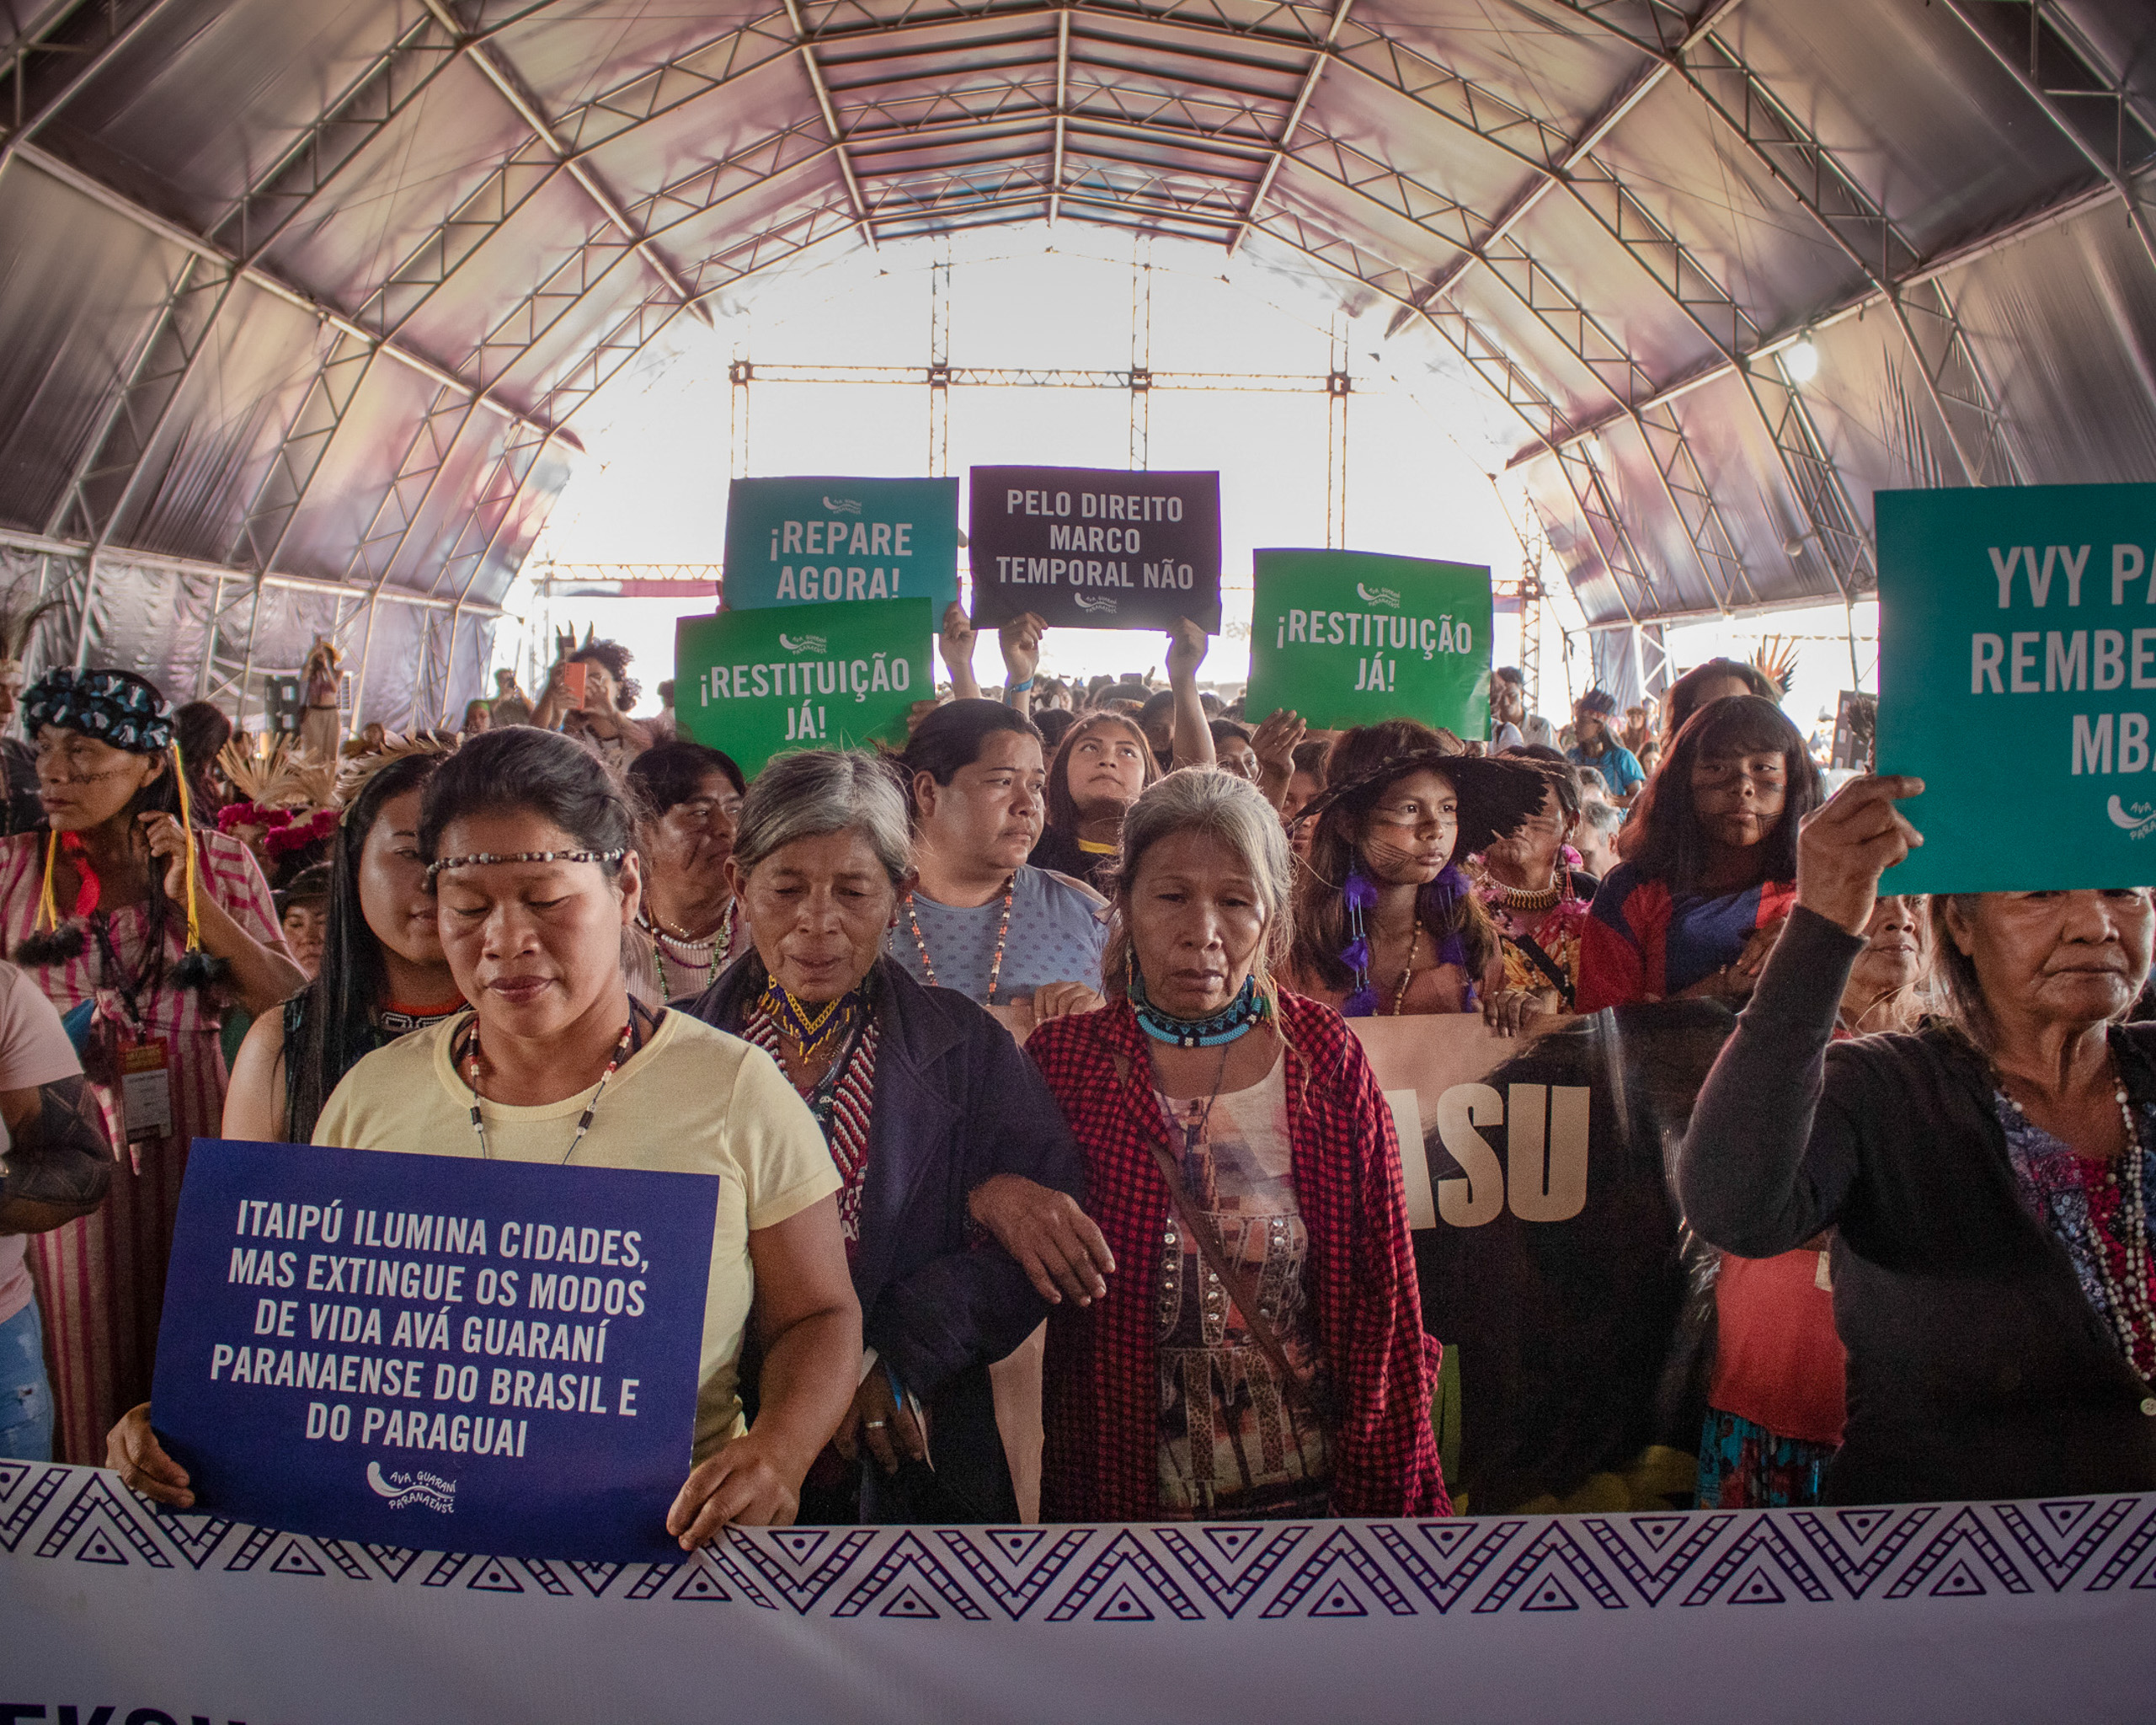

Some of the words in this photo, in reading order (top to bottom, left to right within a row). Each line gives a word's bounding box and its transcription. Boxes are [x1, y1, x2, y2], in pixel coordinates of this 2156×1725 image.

[1007, 489, 1071, 516] PELO
[1081, 492, 1183, 522] DIREITO
[770, 521, 913, 562] ¡REPARE
[1050, 524, 1141, 554] MARCO
[775, 565, 899, 601] AGORA!
[995, 556, 1134, 587] TEMPORAL
[1143, 558, 1193, 590] NÃO
[1988, 544, 2091, 608] YVY
[2111, 543, 2156, 606] P
[1276, 608, 1472, 660] ¡RESTITUIÇÃO
[700, 652, 910, 708] ¡RESTITUIÇÃO
[1354, 651, 1396, 692] JÁ!
[784, 698, 826, 740] JÁ!
[2071, 713, 2156, 776] MB
[236, 1199, 343, 1243] ITAIPÚ
[353, 1210, 487, 1255] ILUMINA
[499, 1221, 649, 1274] CIDADES,
[227, 1247, 297, 1288] MAS
[306, 1254, 466, 1303] EXTINGUE
[475, 1268, 520, 1307] OS
[528, 1273, 647, 1317] MODOS
[253, 1298, 298, 1338] DE
[309, 1303, 382, 1345] VIDA
[391, 1305, 450, 1351] AVÁ
[461, 1316, 611, 1365] GUARANÍ
[210, 1344, 424, 1399] PARANAENSE
[433, 1364, 478, 1403] DO
[488, 1368, 607, 1414] BRASIL
[618, 1378, 640, 1417] E
[306, 1402, 350, 1442] DO
[361, 1407, 528, 1458] PARAGUAI
[387, 1492, 455, 1514] PARANAENSE
[389, 1471, 412, 1485] AVA
[416, 1471, 456, 1493] GUARANÍ
